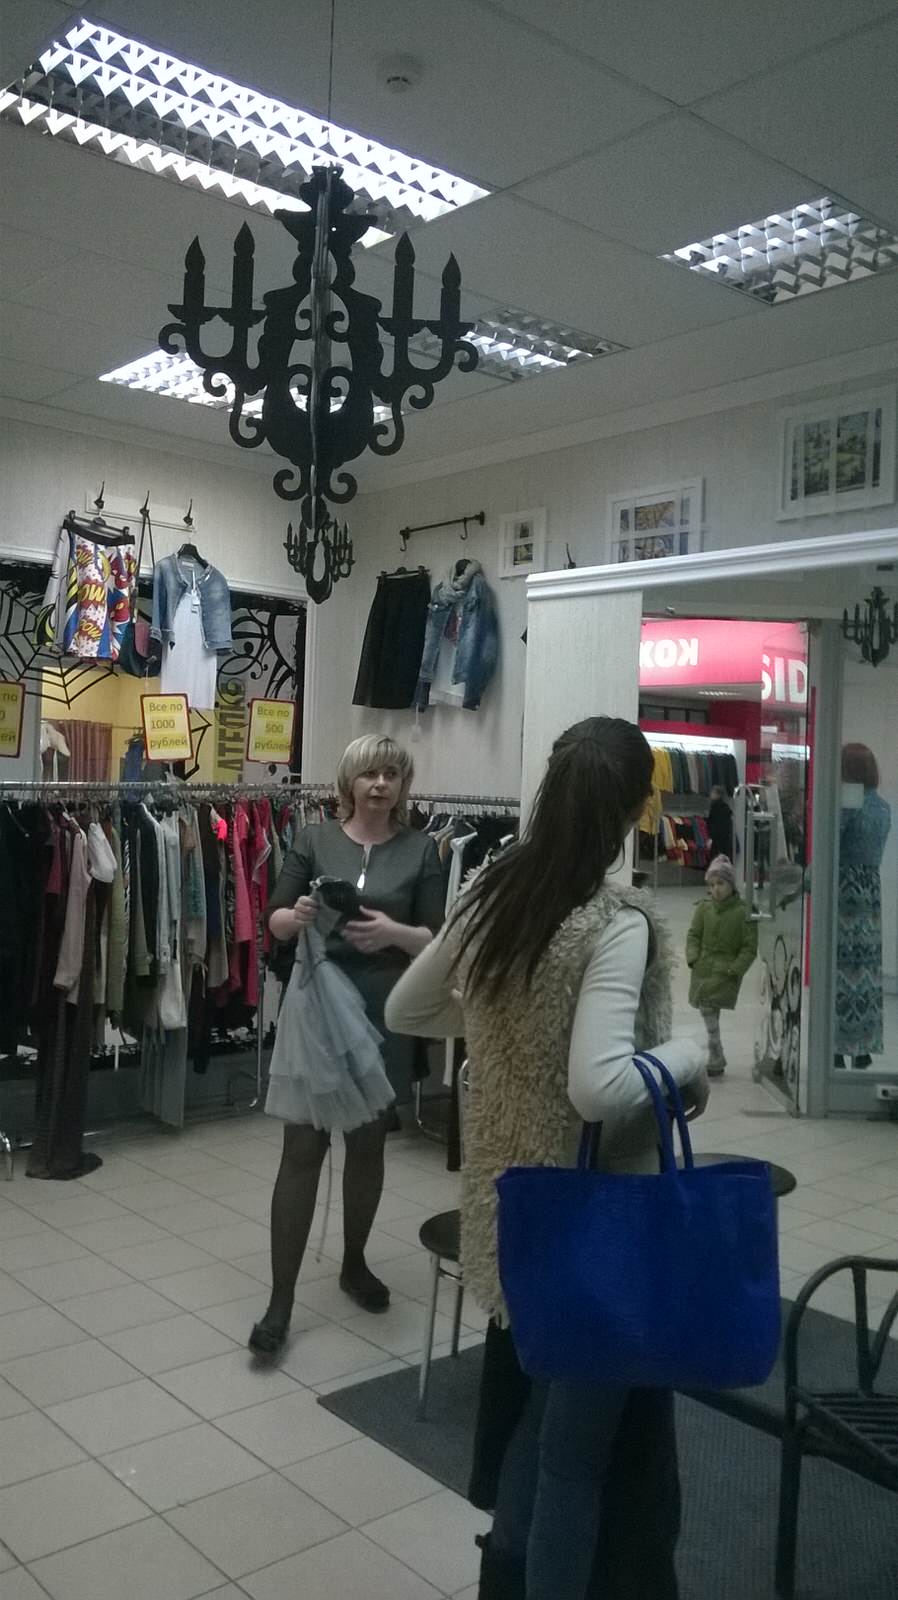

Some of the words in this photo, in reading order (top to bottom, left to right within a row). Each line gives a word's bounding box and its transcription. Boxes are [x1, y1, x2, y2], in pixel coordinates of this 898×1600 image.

[149, 702, 167, 712] Все
[170, 703, 183, 711] по
[257, 706, 273, 716] Все
[277, 710, 289, 718] по
[151, 719, 175, 729] 1000
[265, 722, 284, 733] 500
[150, 736, 189, 749] рублей
